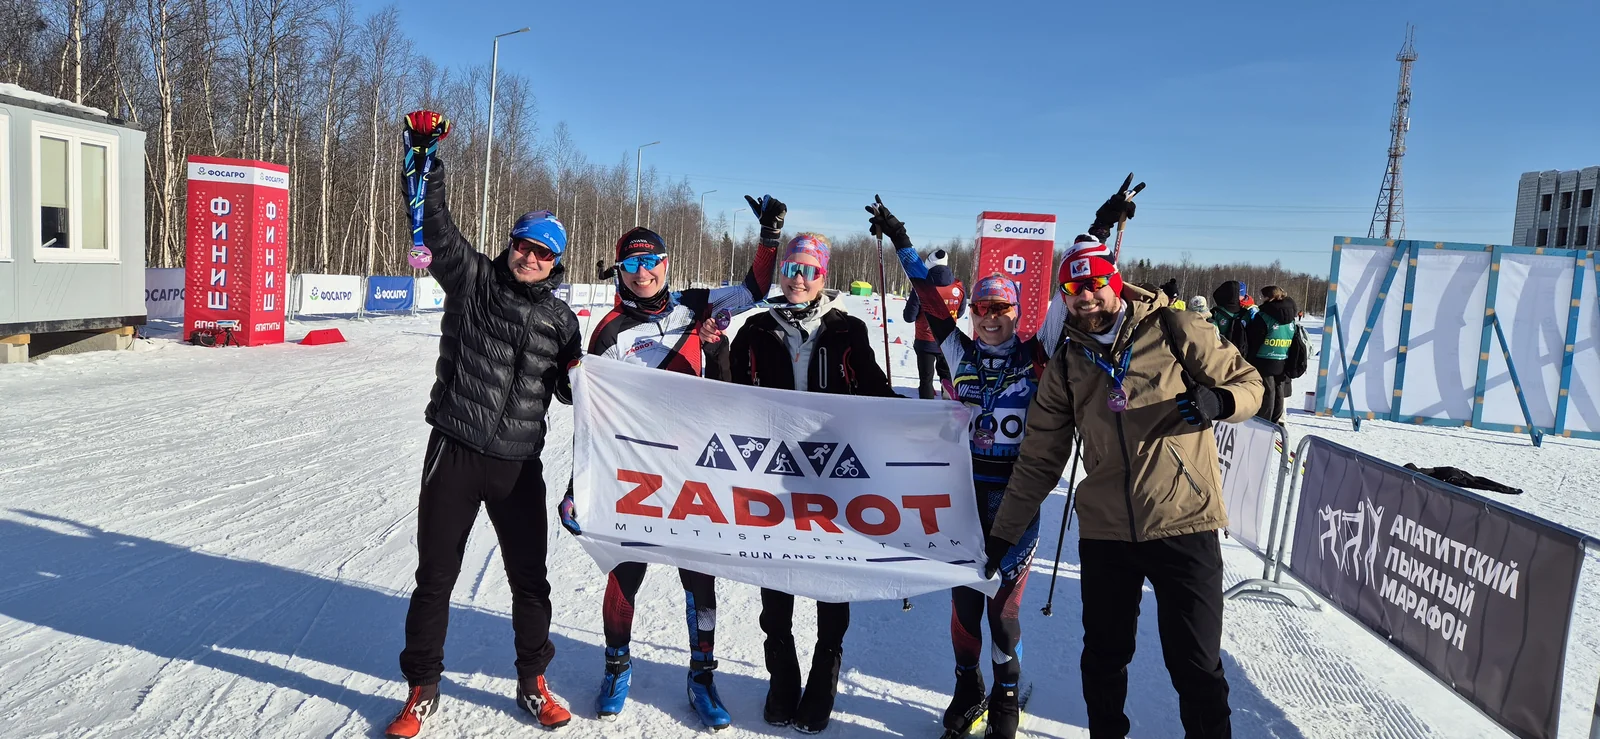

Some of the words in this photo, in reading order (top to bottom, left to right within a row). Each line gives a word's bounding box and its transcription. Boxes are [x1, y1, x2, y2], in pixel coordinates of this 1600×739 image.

[207, 169, 245, 179] ФОСАГРО
[264, 175, 285, 184] ФОСАГРО
[1004, 226, 1045, 235] ФОСАГРО
[207, 196, 231, 310] ФИНИШ
[263, 201, 277, 311] ФИНИШ
[145, 288, 185, 302] ОСАГРО
[321, 291, 352, 301] ФОСАГРО
[381, 289, 408, 299] ФОСАГРО
[255, 322, 280, 332] АПАТИТЫ
[615, 468, 951, 536] ZADROT
[615, 522, 844, 545] MULTISPORT
[879, 539, 962, 549] TEAM
[739, 551, 773, 559] RUN
[1389, 514, 1519, 600] АПАТИТСКИЙ
[1379, 573, 1467, 651] МАРАФОН
